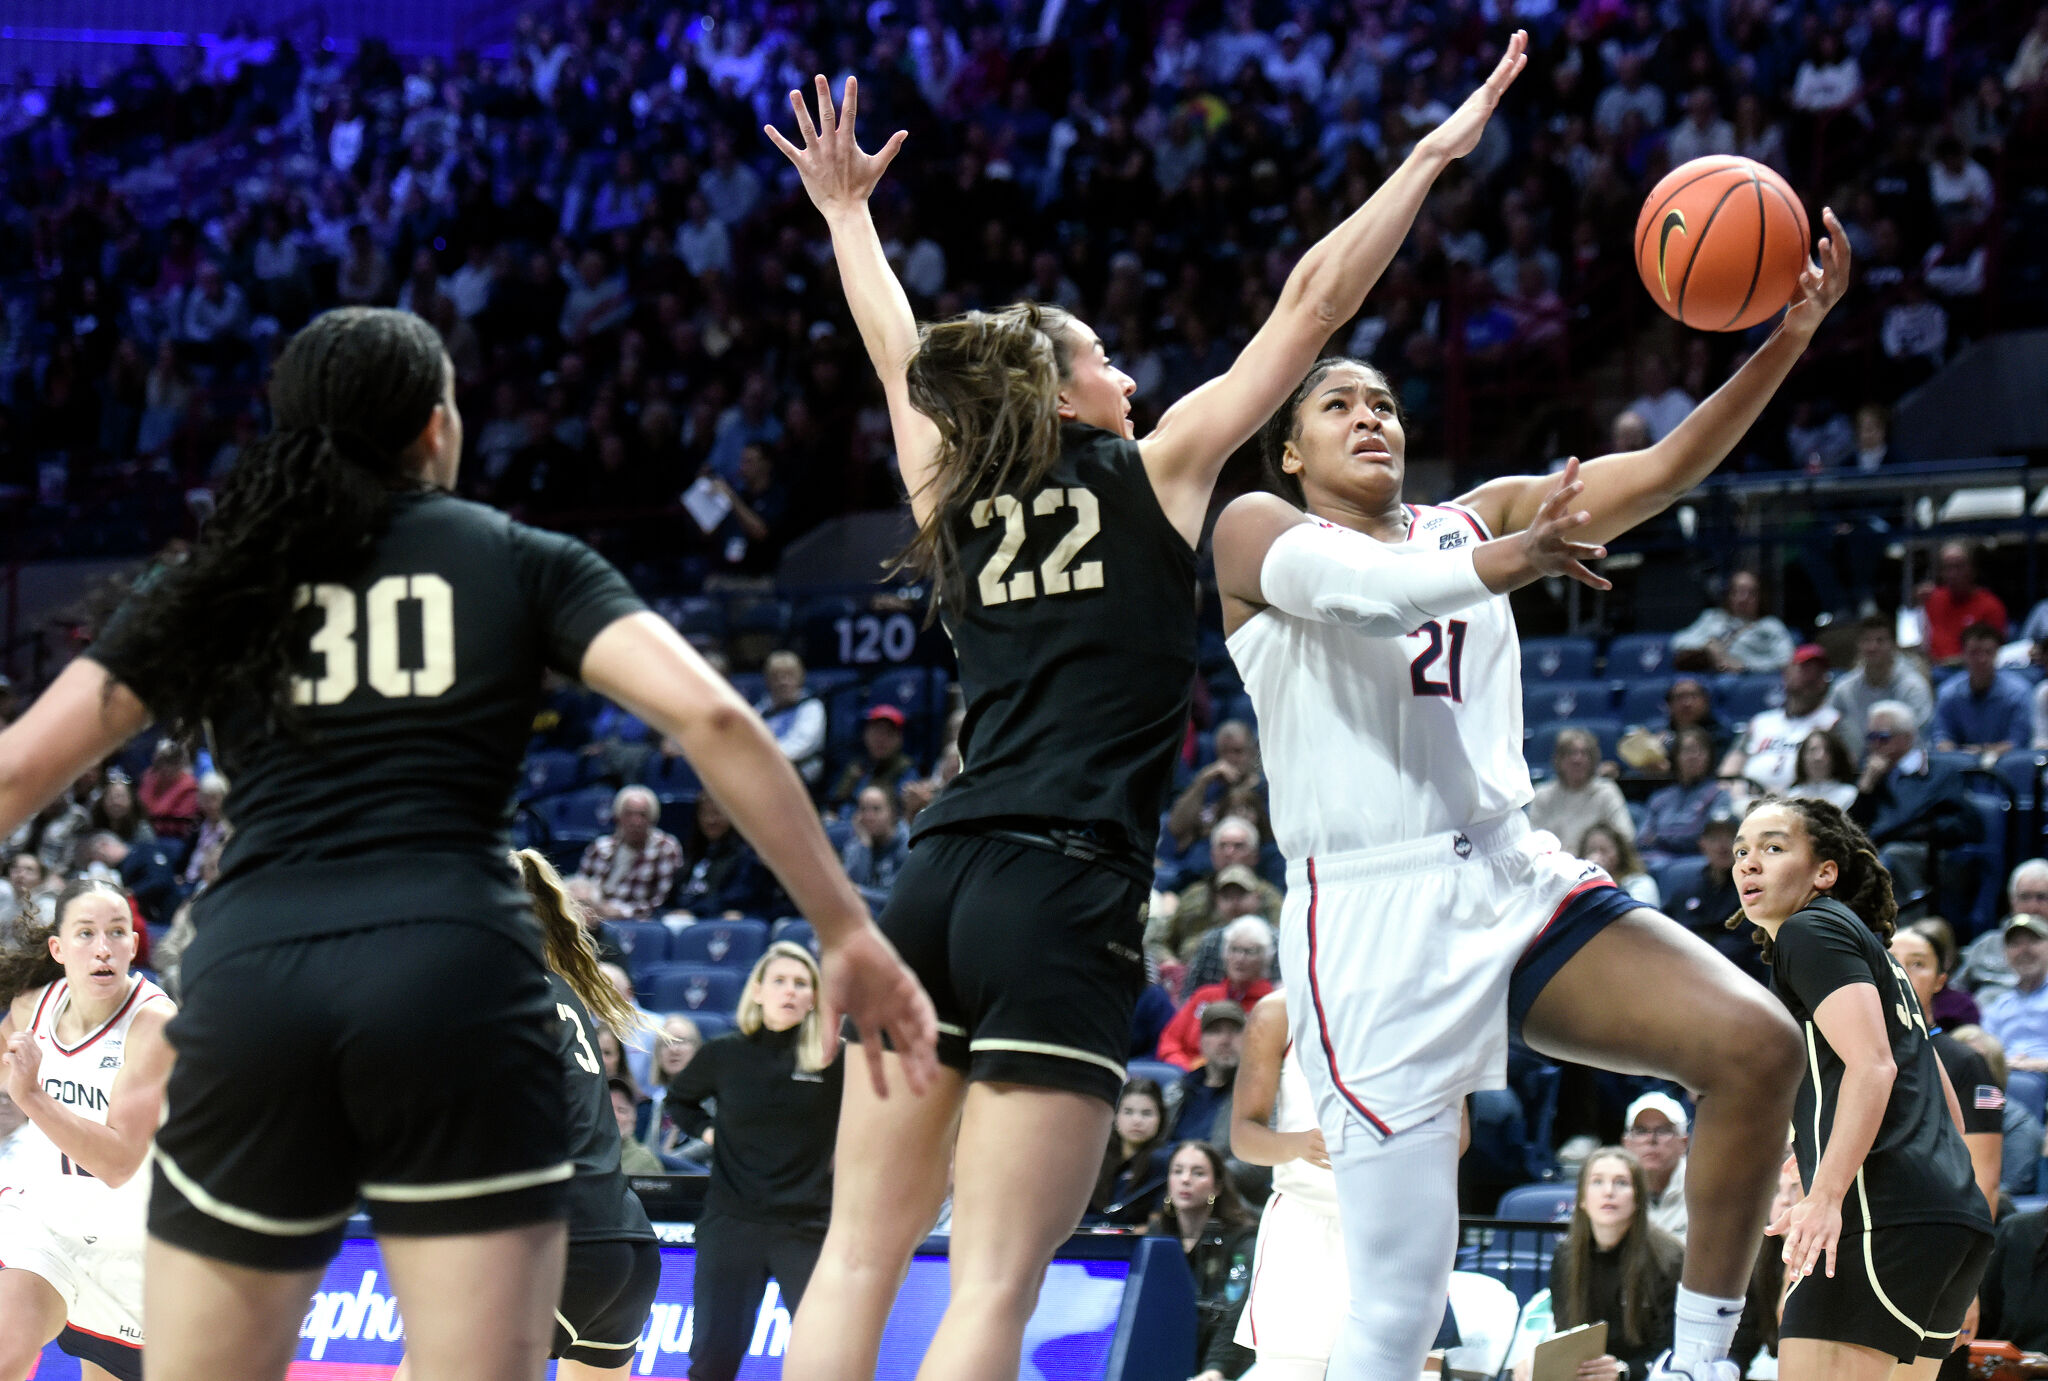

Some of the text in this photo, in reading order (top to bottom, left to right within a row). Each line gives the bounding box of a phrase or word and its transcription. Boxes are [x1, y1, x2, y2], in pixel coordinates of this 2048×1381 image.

[970, 487, 1105, 607] 22
[1439, 530, 1461, 544] BIG
[1439, 535, 1469, 551] EAST
[290, 573, 456, 706] 30
[834, 614, 916, 663] 120
[1406, 619, 1468, 704] 21
[556, 1002, 600, 1075] 3
